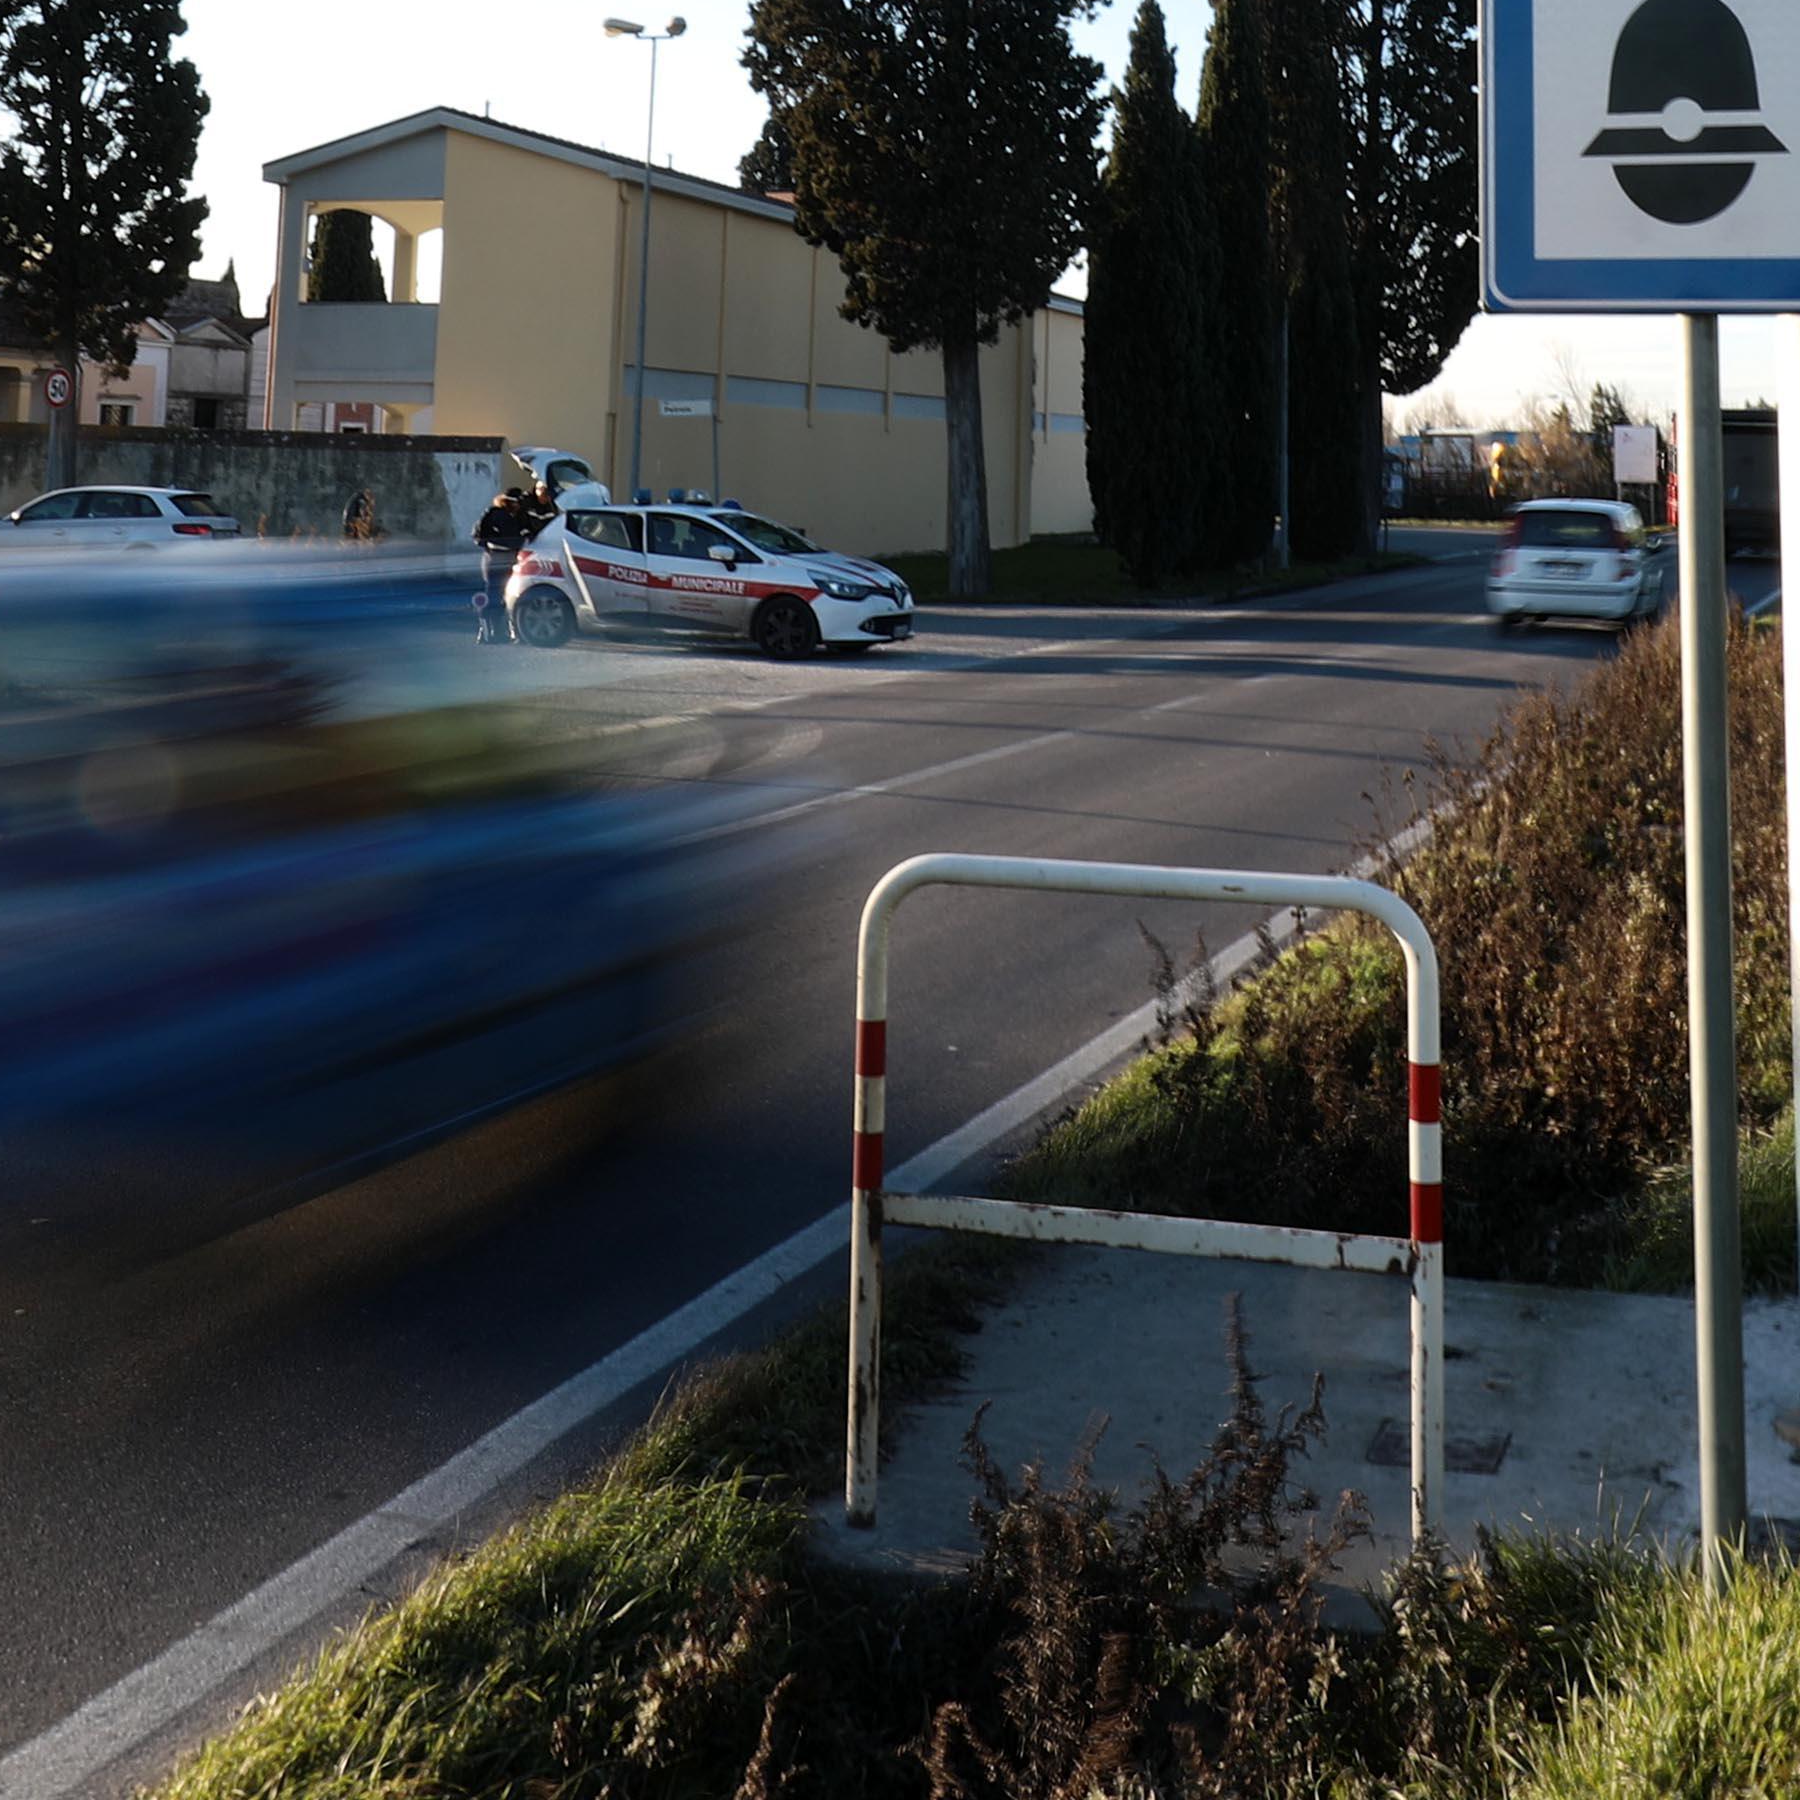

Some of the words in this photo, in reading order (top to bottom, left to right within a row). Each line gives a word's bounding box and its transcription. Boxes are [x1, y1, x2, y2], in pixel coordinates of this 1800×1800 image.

[51, 378, 66, 398] 50
[608, 565, 648, 583] POLIZIA
[671, 574, 745, 594] MUNICIPALE
